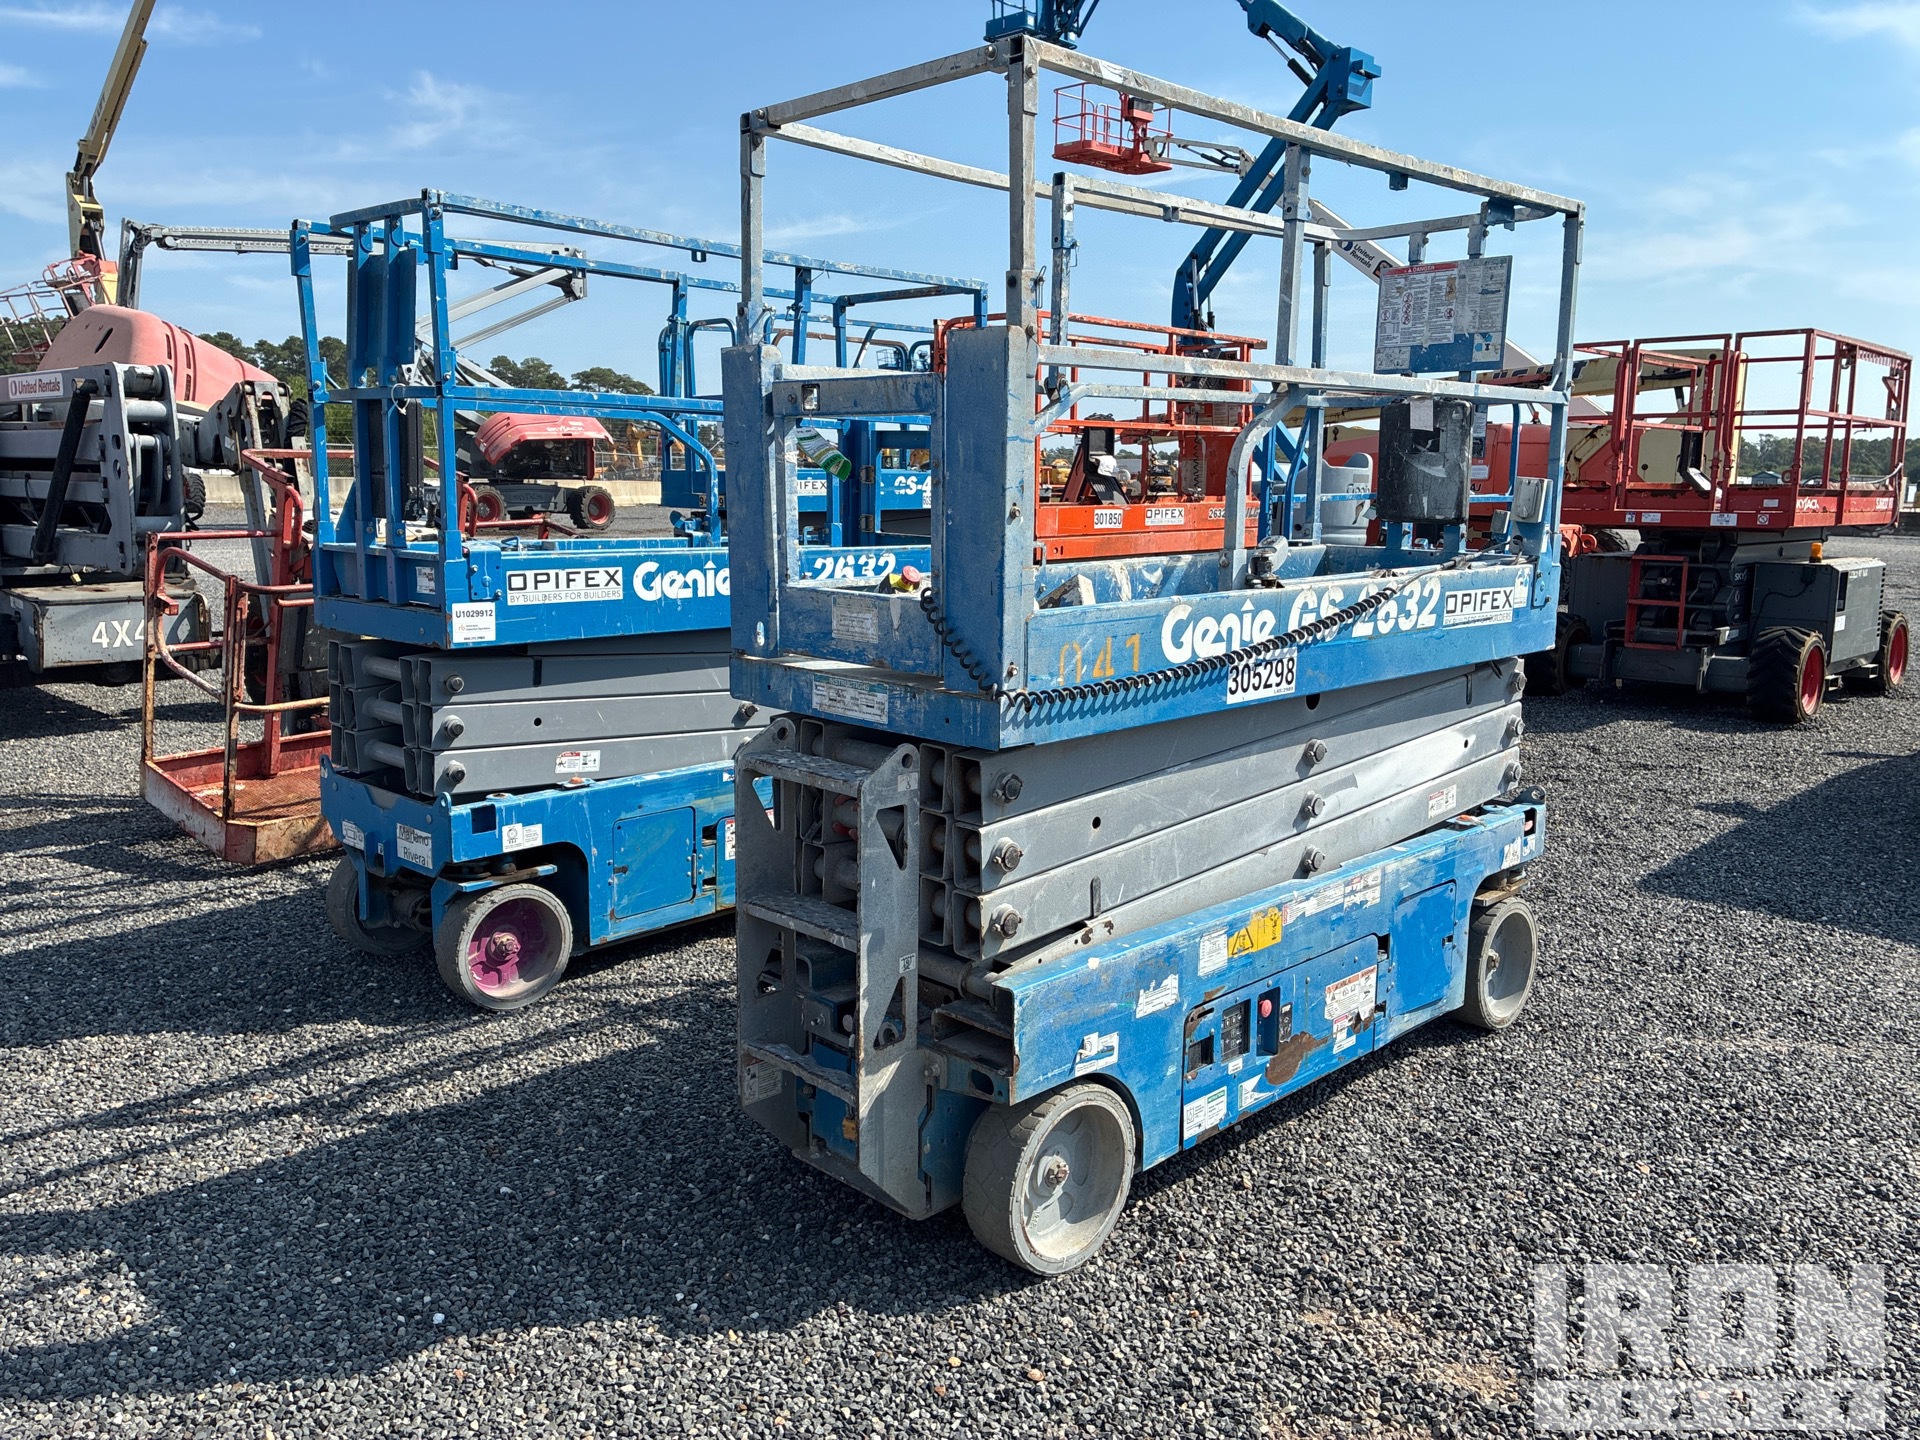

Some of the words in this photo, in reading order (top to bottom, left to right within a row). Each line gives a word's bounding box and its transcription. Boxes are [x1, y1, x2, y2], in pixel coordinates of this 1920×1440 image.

[1350, 250, 1371, 268] Rentals
[1353, 244, 1375, 261] United
[1412, 265, 1435, 273] DANGER
[18, 380, 37, 395] United
[38, 378, 60, 393] Rentals
[797, 481, 827, 490] IFEX
[1796, 497, 1819, 511] KYJACK
[1094, 512, 1122, 526] 301850
[1146, 508, 1184, 518] OPIFEX
[507, 569, 621, 591] OPIFEX
[510, 594, 520, 603] BY
[522, 593, 563, 602] BUILDERS
[565, 592, 582, 600] FOR
[583, 590, 621, 599] BUILDERS
[1445, 589, 1514, 614] OPIFEX
[456, 609, 493, 618] U1029912
[1161, 598, 1276, 664] Genie
[1288, 576, 1441, 643] GS2632
[1229, 657, 1295, 695] 305298
[829, 677, 870, 691] INSTRUCTIONS
[403, 846, 426, 866] Rivera
